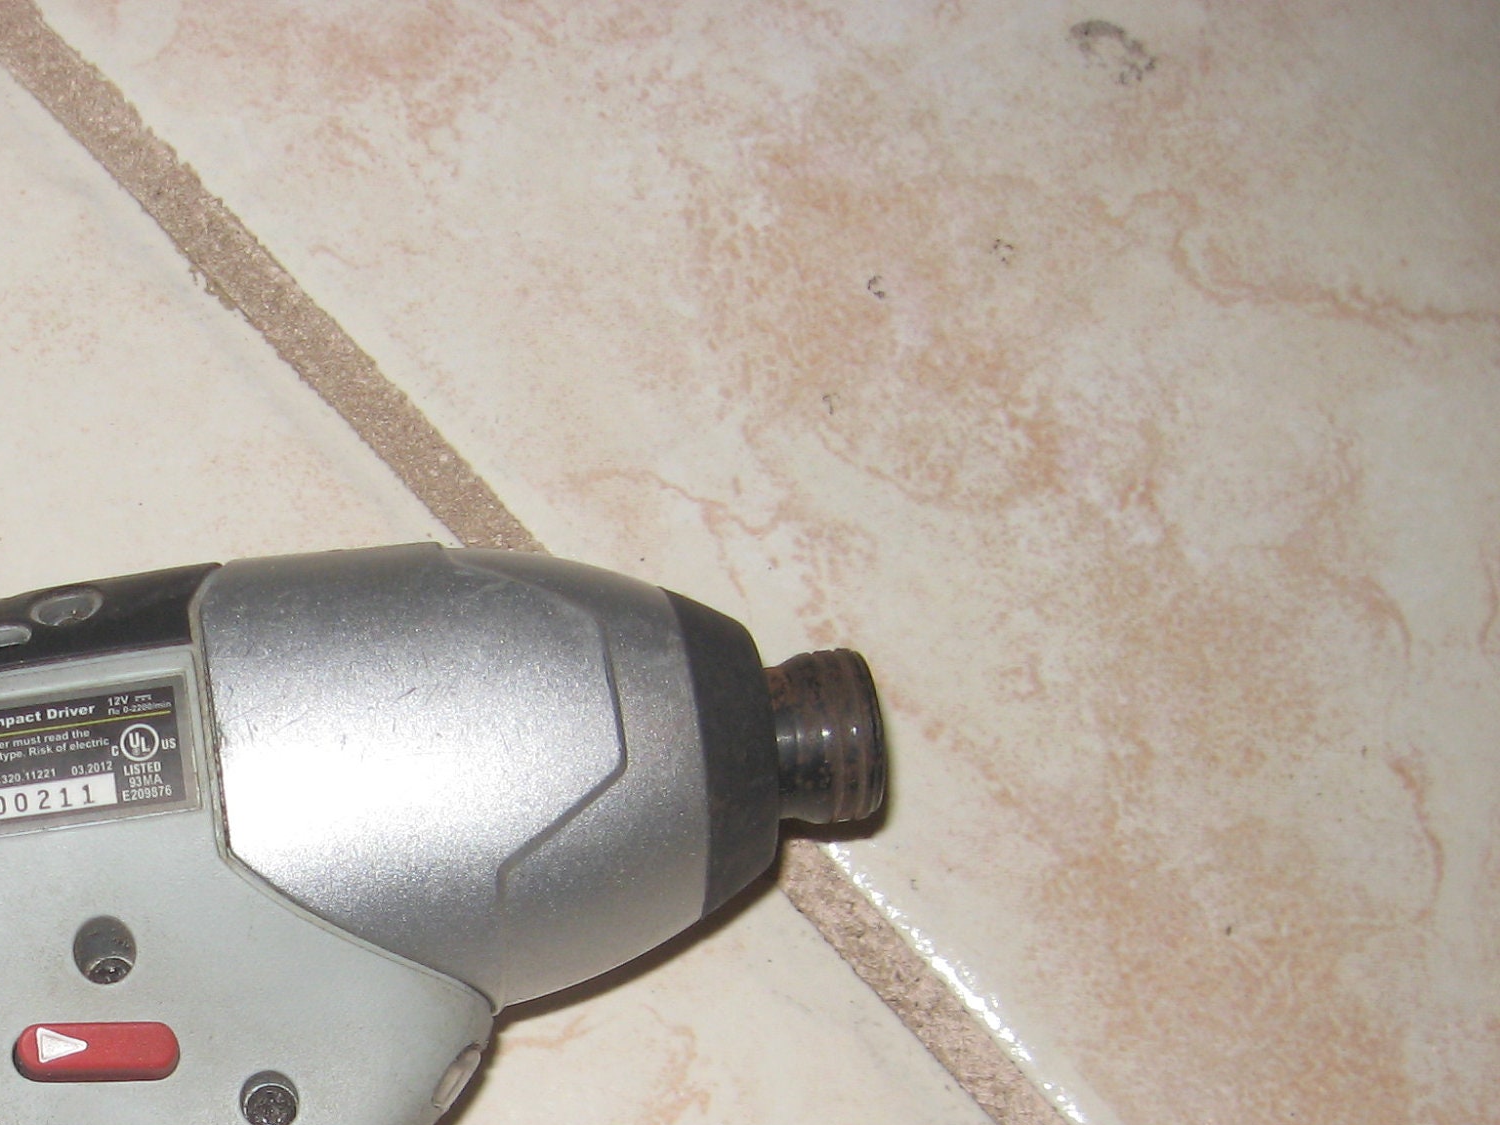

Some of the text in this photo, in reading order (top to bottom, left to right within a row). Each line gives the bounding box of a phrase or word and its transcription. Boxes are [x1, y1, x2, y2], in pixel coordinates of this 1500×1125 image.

[108, 696, 129, 706] 12V
[47, 704, 95, 719] Driver
[13, 736, 41, 748] must
[44, 732, 68, 742] read
[72, 729, 90, 739] the
[161, 738, 177, 750] US
[0, 751, 26, 763] type.
[29, 745, 52, 756] Risk
[56, 743, 67, 752] of
[70, 737, 109, 751] electric
[124, 761, 161, 776] LISTED
[129, 774, 163, 788] 93MA
